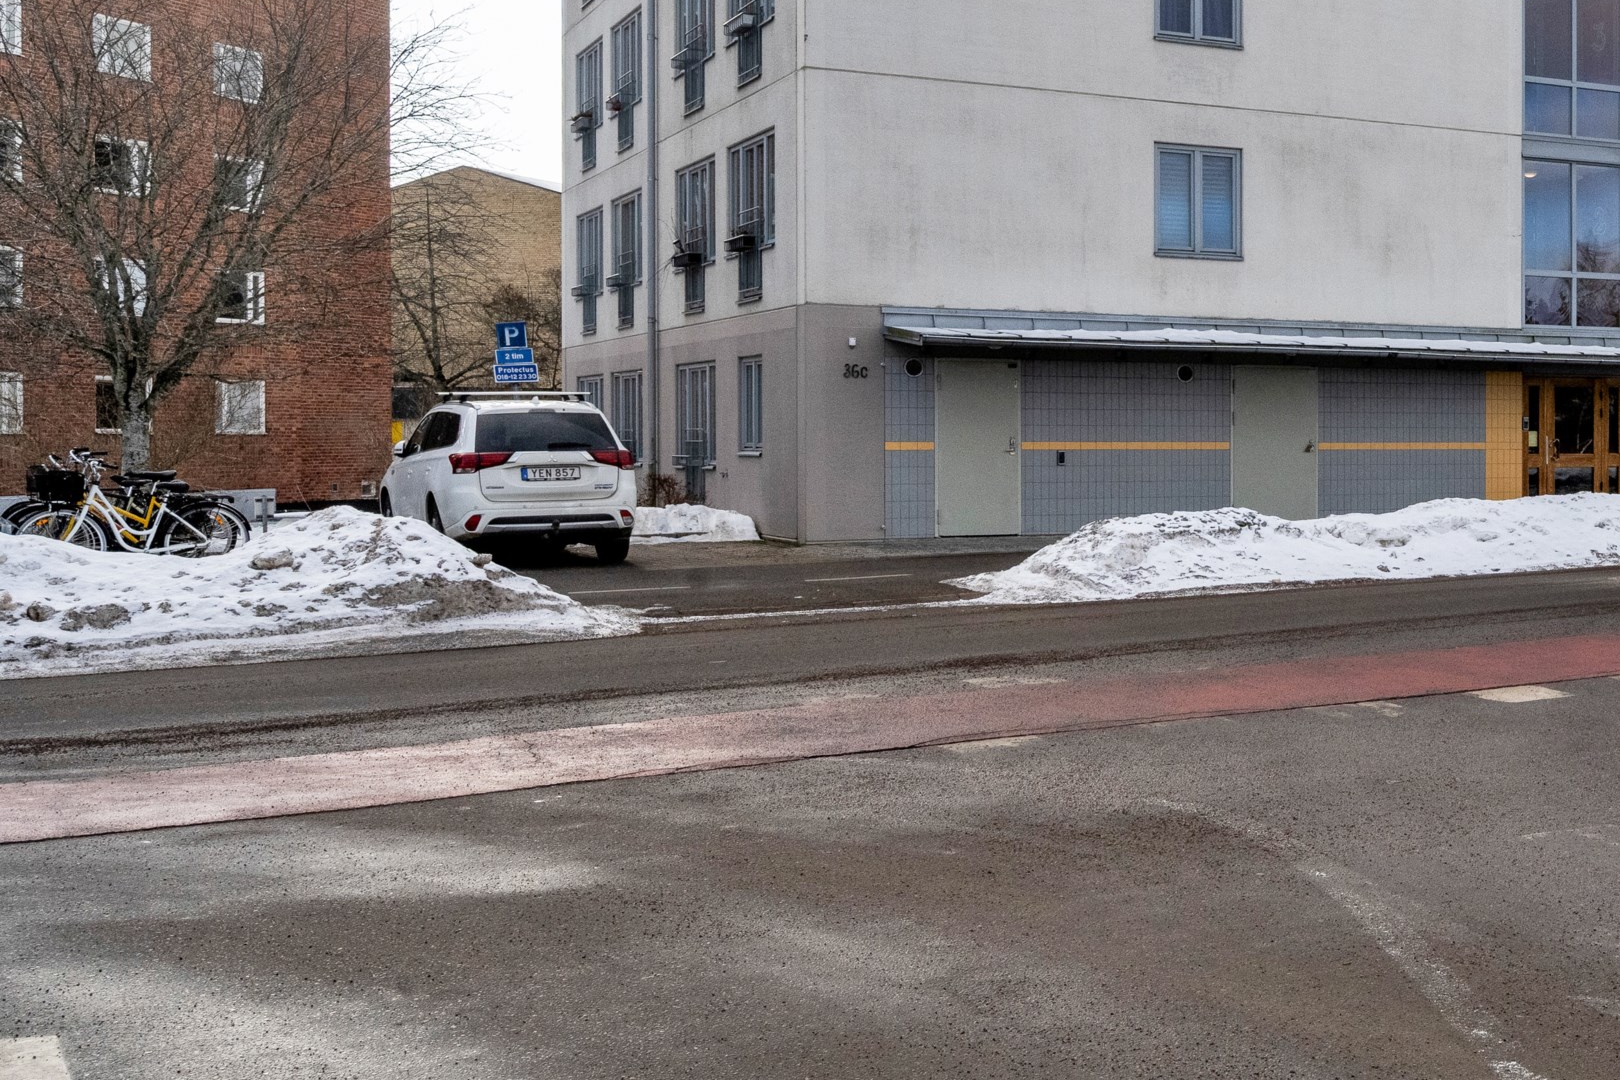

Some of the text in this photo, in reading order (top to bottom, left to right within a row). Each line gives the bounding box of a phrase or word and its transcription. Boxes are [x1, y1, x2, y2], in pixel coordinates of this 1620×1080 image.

[504, 327, 519, 346] P
[531, 468, 575, 478] YEN 857
